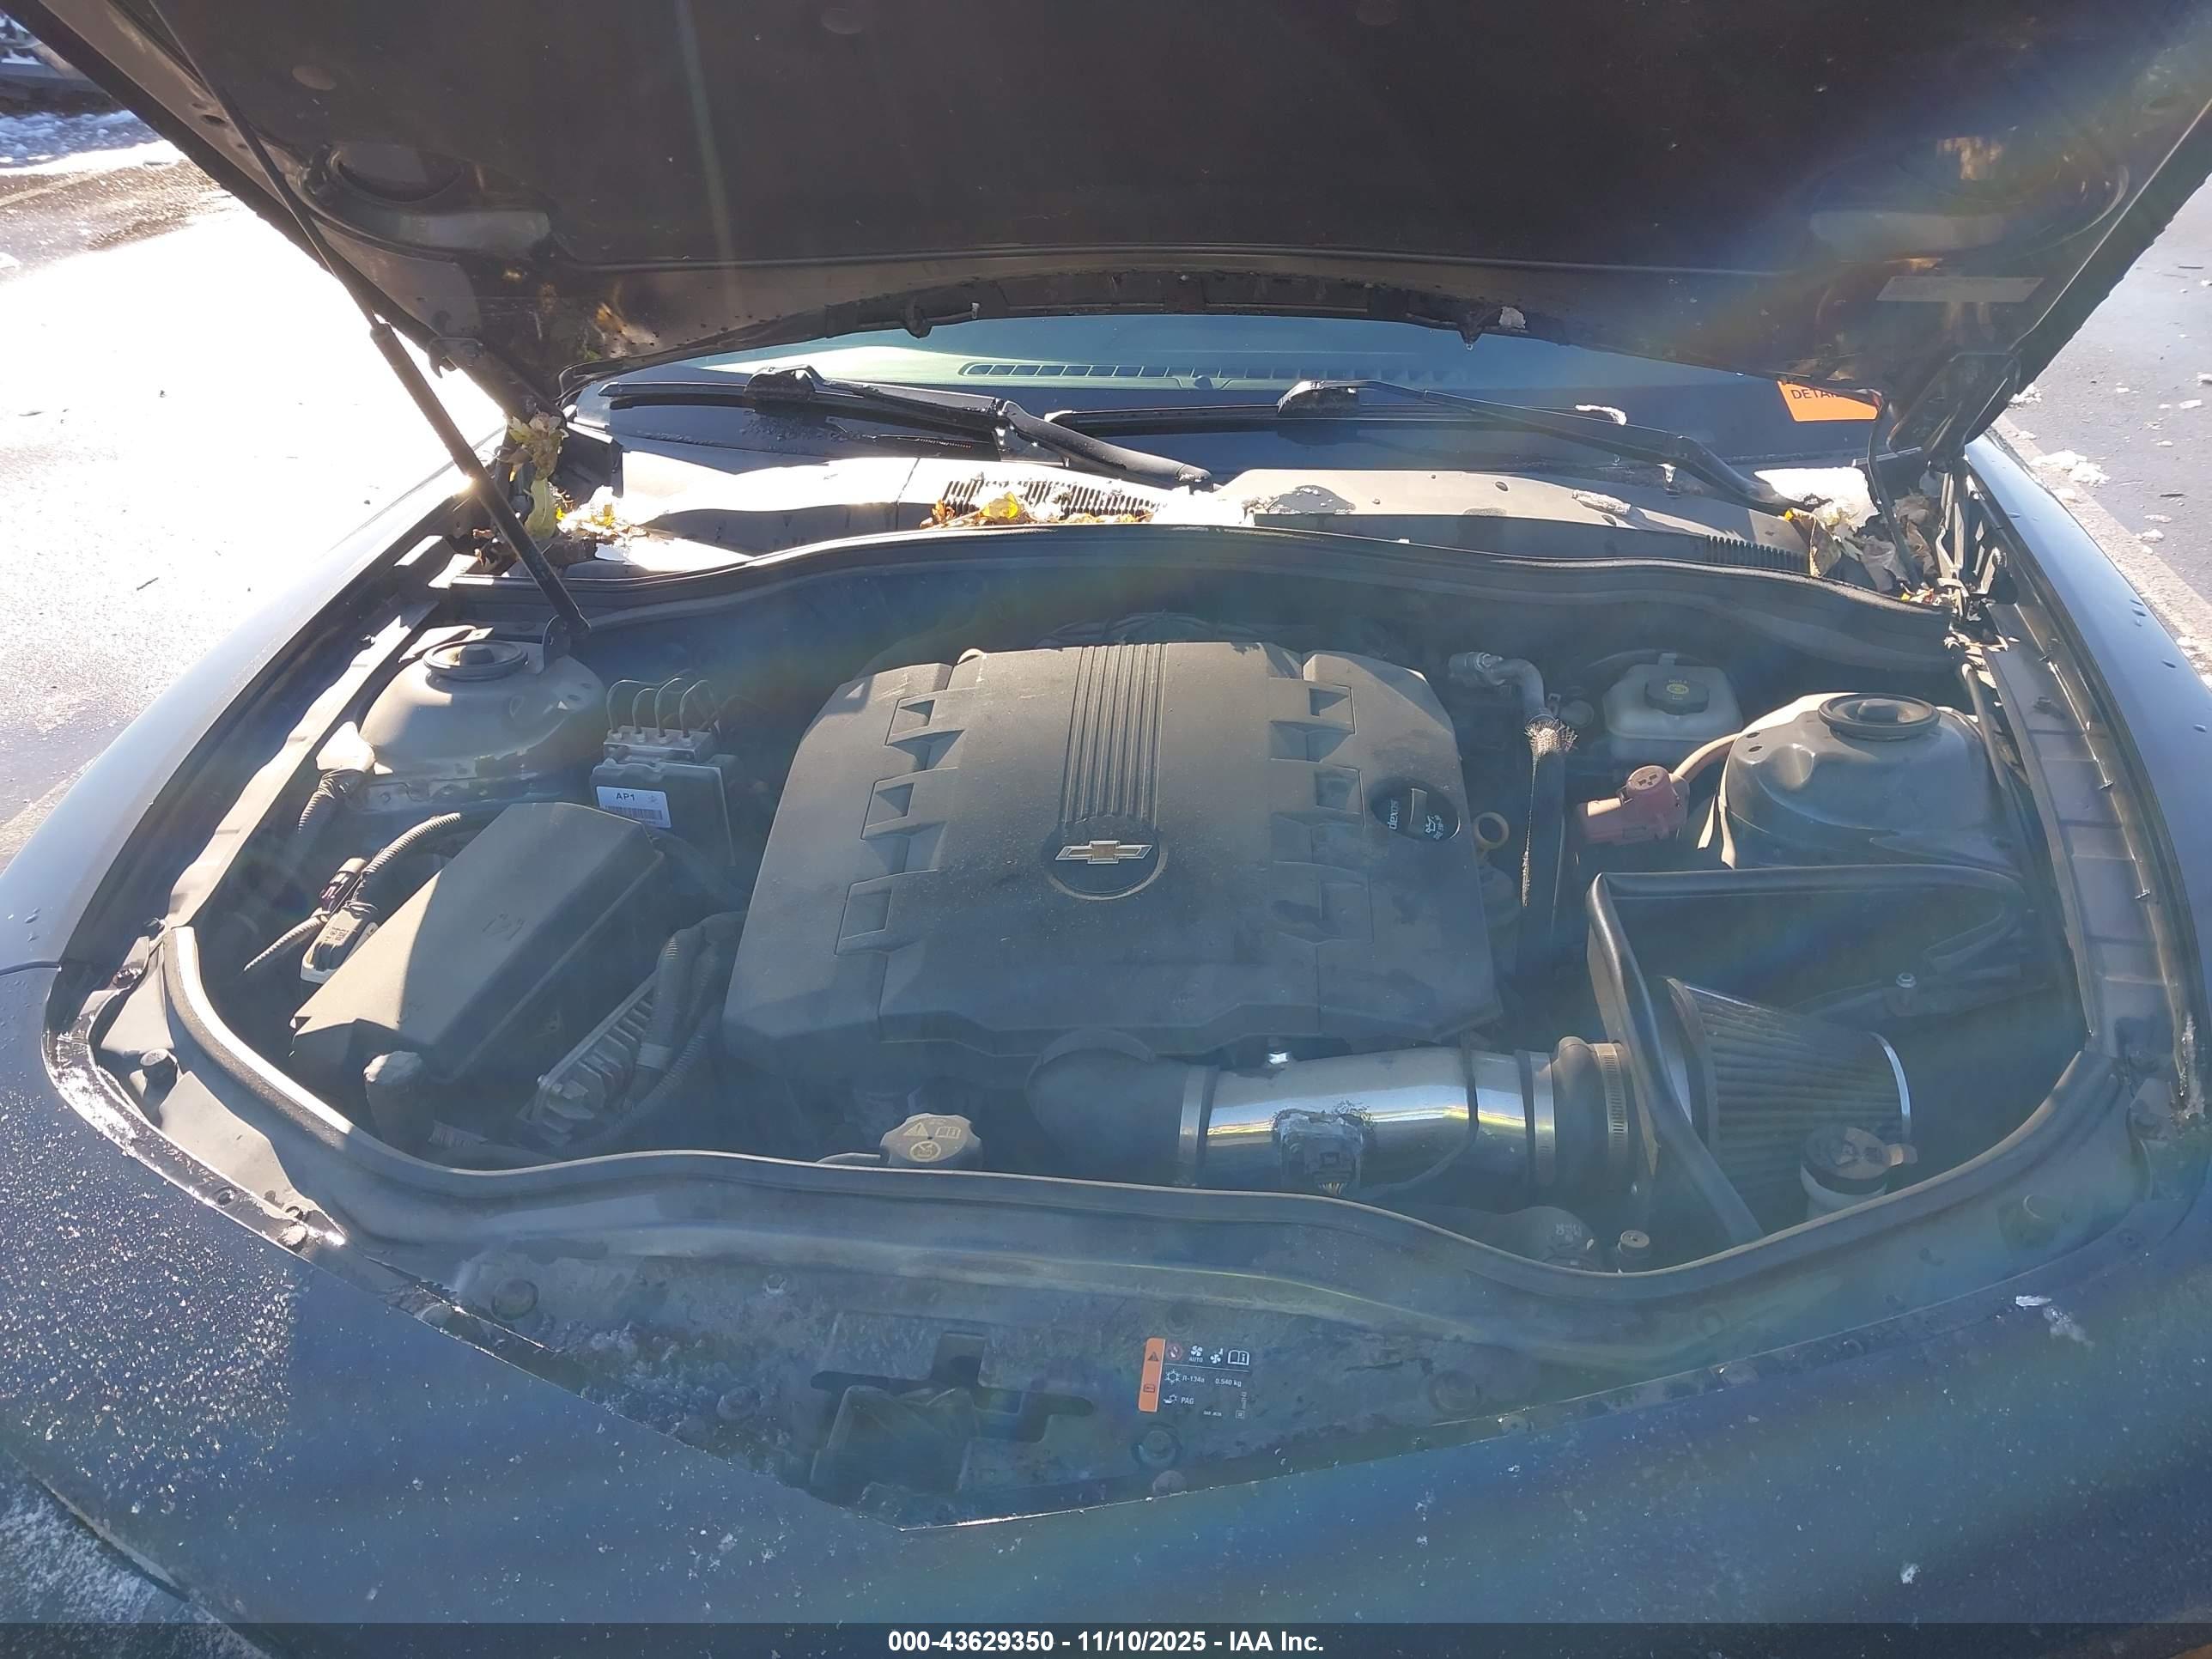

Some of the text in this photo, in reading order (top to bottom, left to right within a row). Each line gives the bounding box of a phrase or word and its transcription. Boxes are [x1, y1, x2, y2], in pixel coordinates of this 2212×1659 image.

[1387, 799, 1399, 830] dexos
[1214, 1377, 1232, 1386] 0.540
[1233, 1379, 1242, 1388] kg
